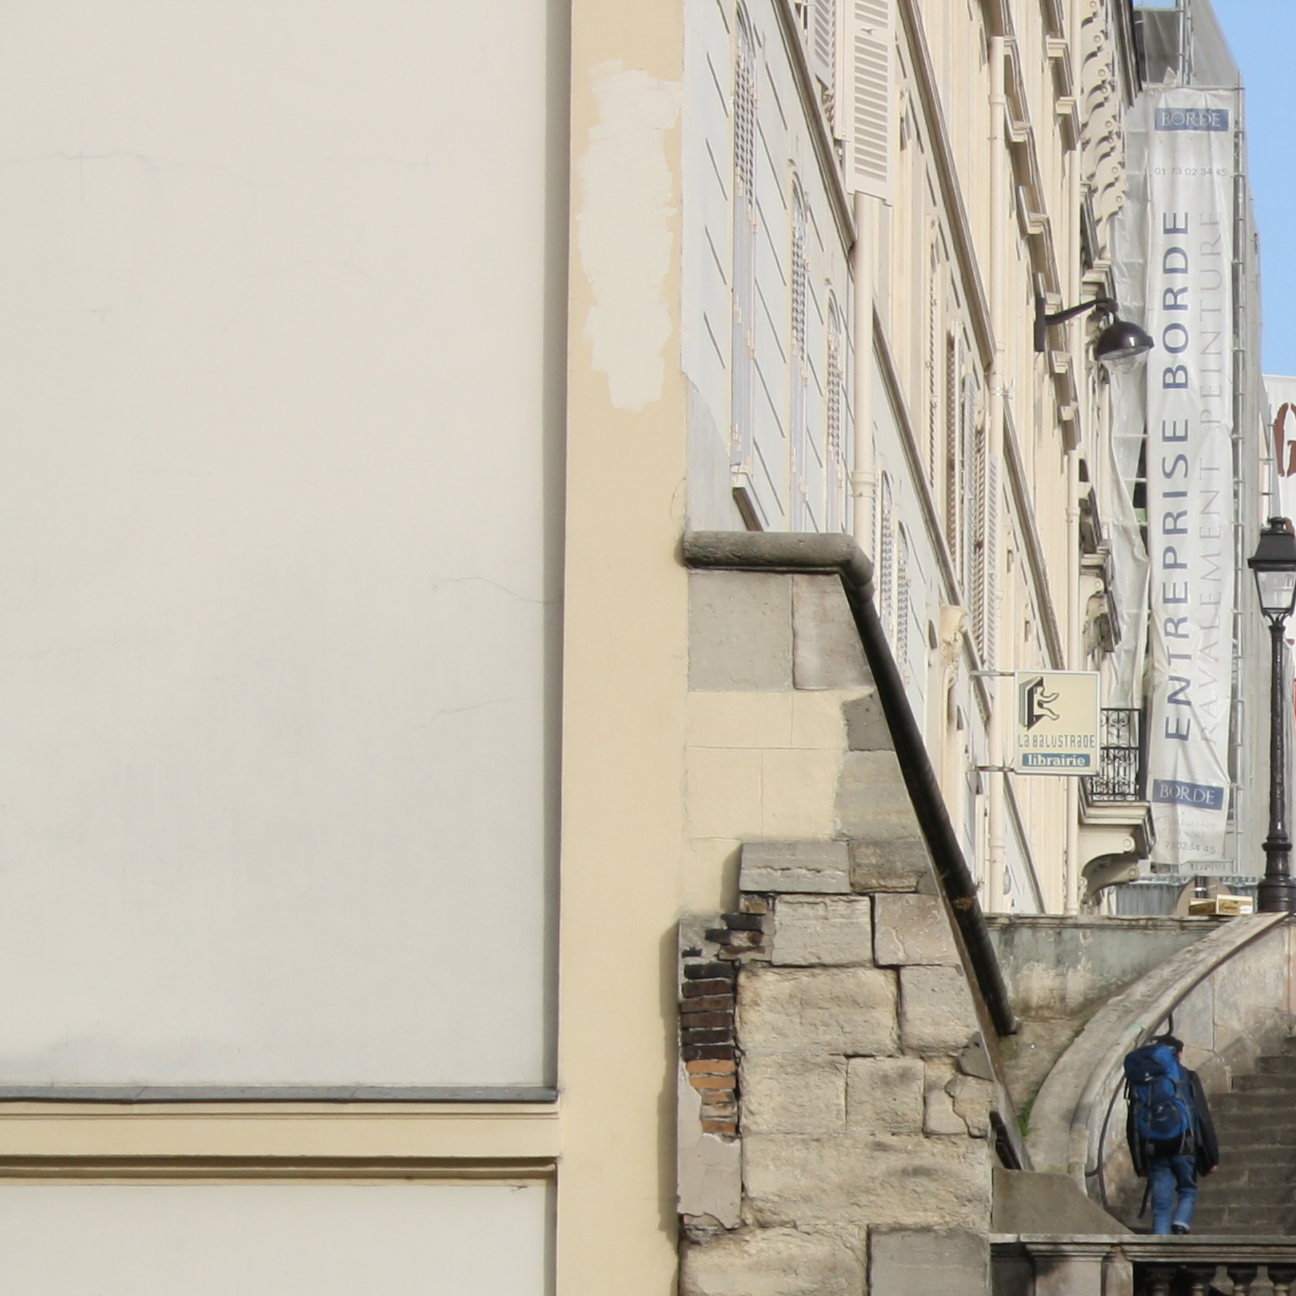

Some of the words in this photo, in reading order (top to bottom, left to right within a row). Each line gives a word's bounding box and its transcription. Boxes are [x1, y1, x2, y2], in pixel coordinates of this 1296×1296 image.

[1161, 111, 1221, 127] BORDE
[1154, 167, 1166, 175] 01
[1185, 167, 1198, 176] 02
[1200, 167, 1213, 176] 34
[1215, 167, 1228, 176] 45
[1162, 211, 1189, 390] BORDE
[1199, 211, 1223, 426] PEINTURE
[1161, 418, 1193, 742] ENTREPRISE
[1199, 457, 1222, 746] RAVALEMENT
[1027, 753, 1086, 767] librairie
[1159, 783, 1216, 805] BORDE
